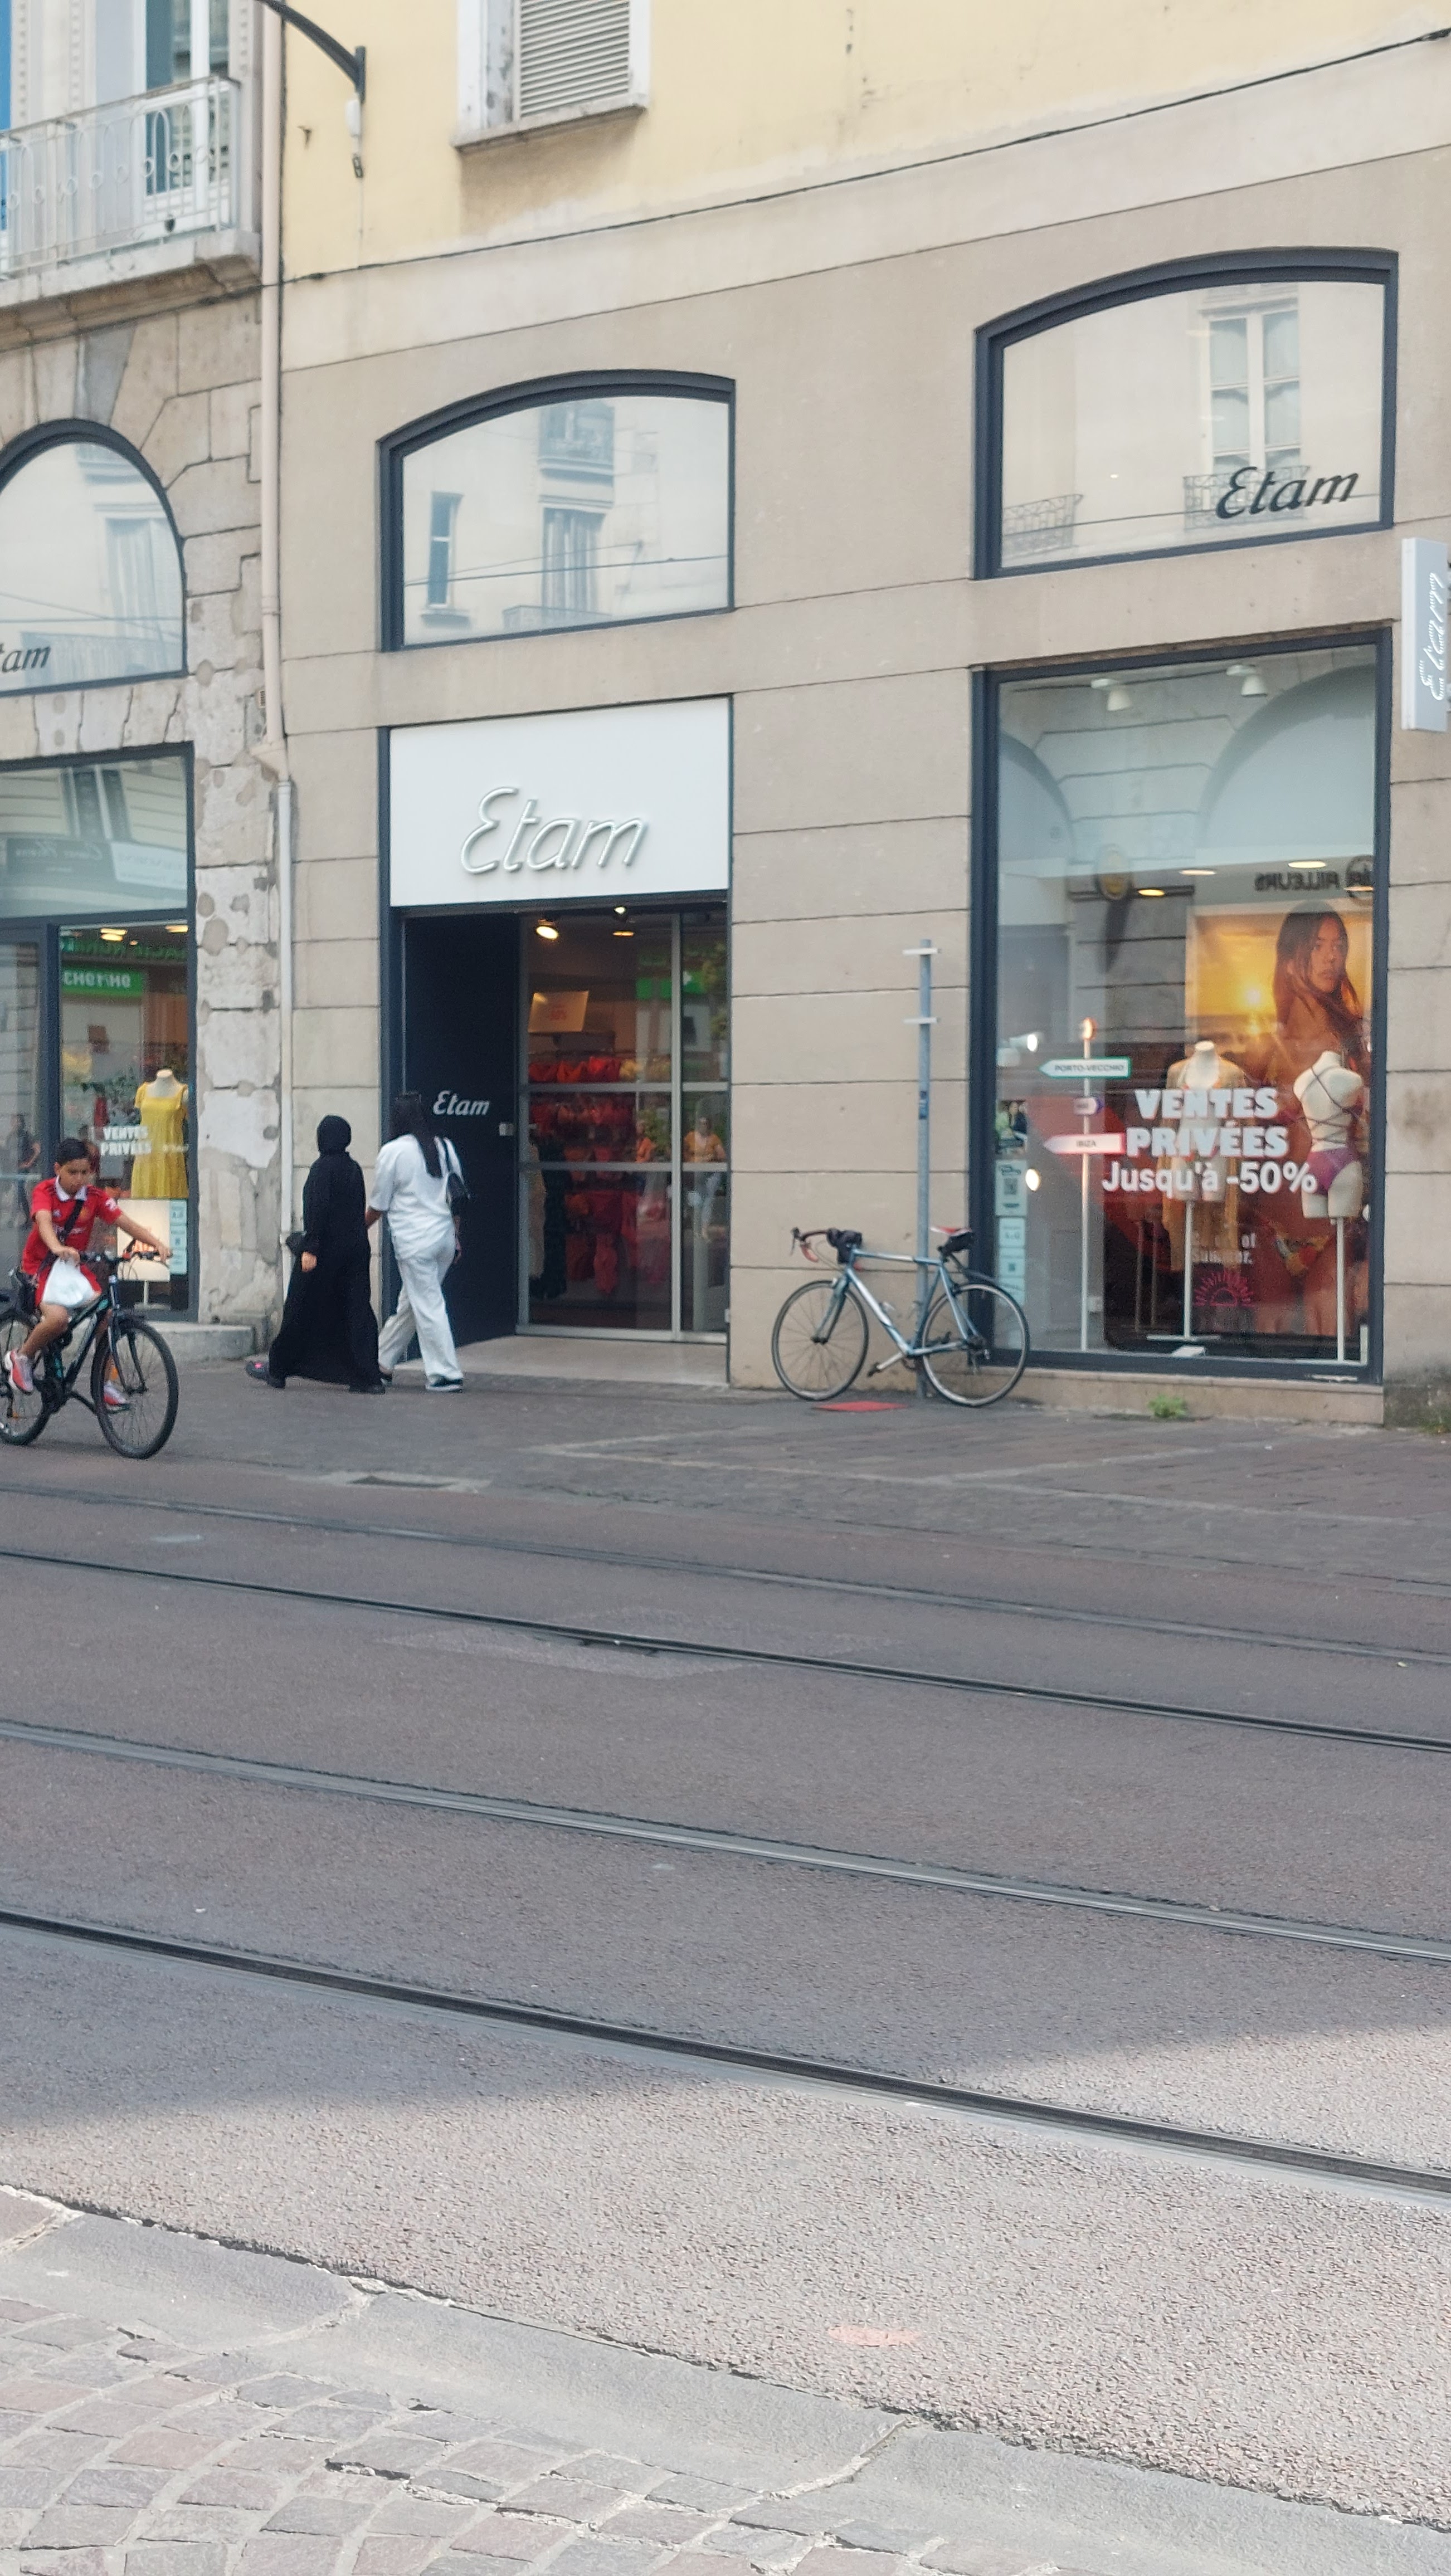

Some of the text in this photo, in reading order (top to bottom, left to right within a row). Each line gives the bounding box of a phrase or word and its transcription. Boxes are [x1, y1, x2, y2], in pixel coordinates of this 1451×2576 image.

[1215, 466, 1359, 520] Etam
[1419, 572, 1445, 701] Etam
[0, 643, 51, 673] am
[460, 786, 647, 875] Etam
[432, 1090, 490, 1116] Etam
[1134, 1087, 1280, 1120] VENTES
[1126, 1120, 1290, 1158] PRIVÉES
[1102, 1160, 1318, 1198] Jusqu'à -50%
